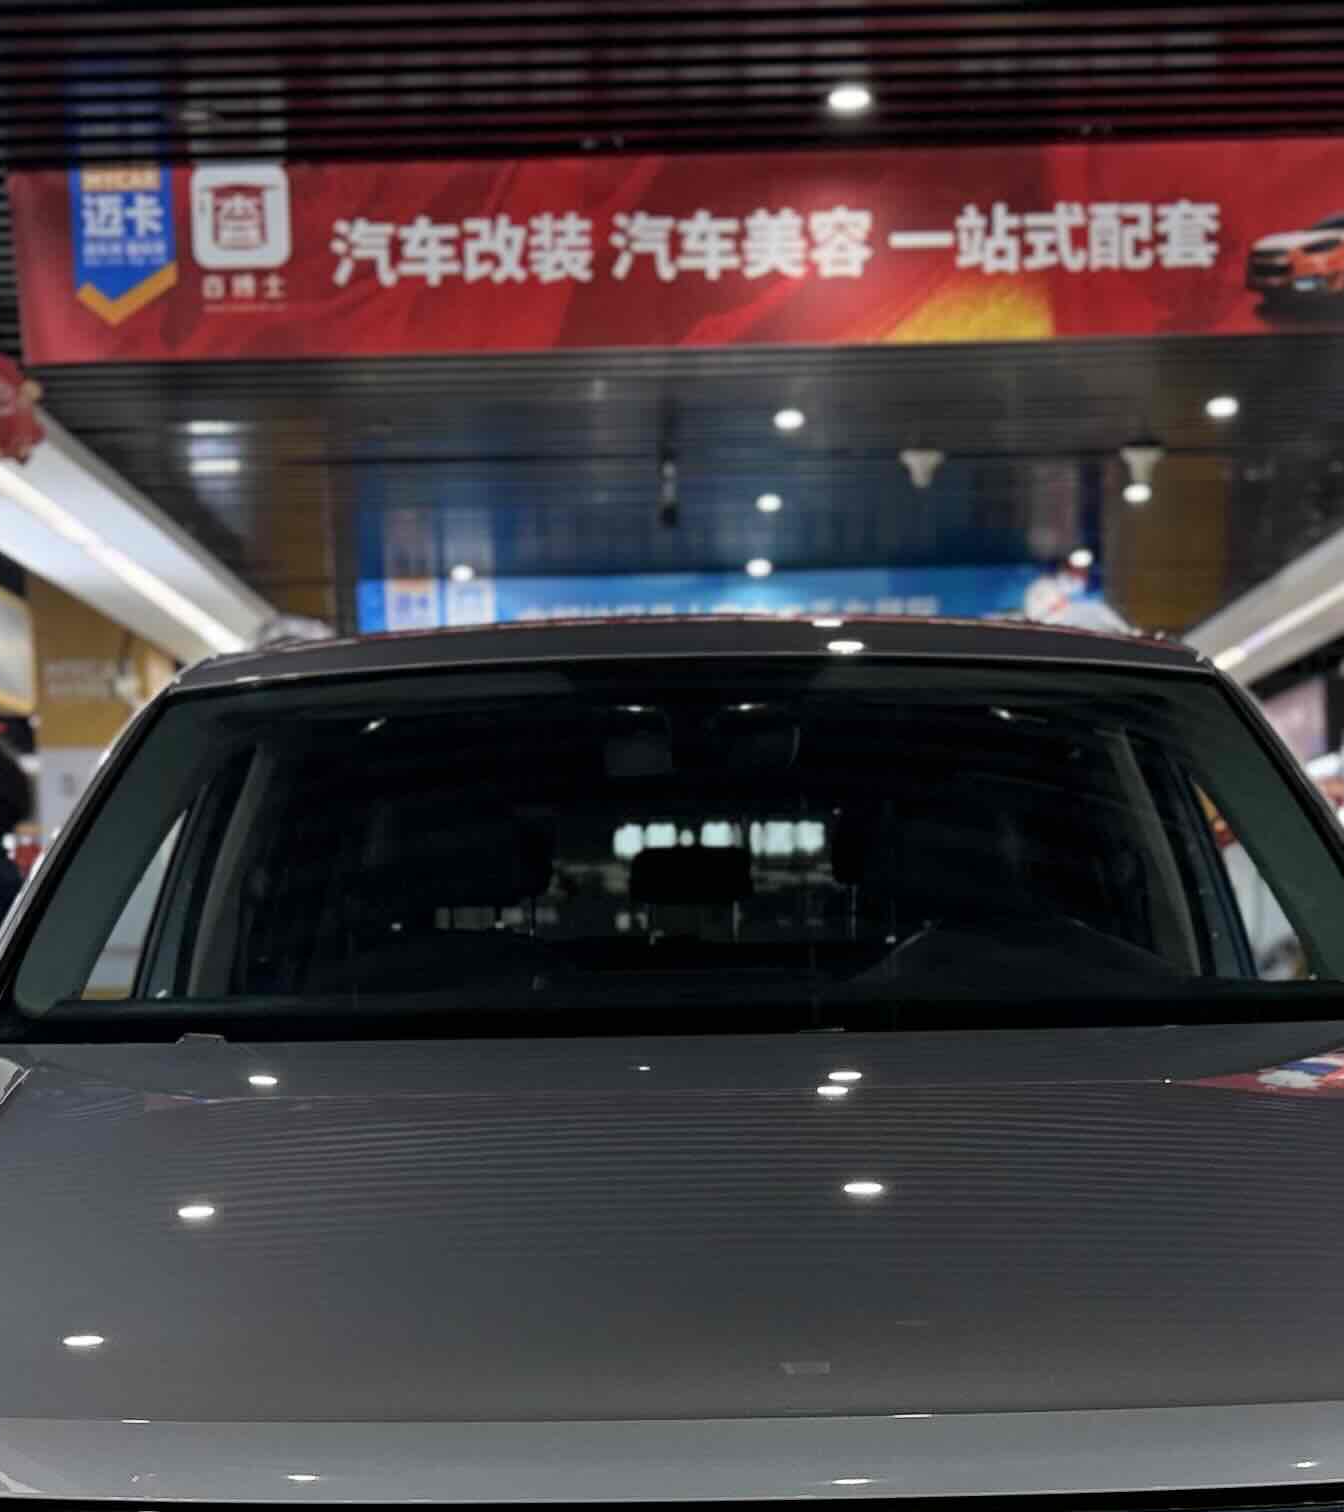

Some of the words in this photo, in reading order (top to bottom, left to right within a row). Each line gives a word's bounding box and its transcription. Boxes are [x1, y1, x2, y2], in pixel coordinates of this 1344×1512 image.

[82, 194, 164, 237] 迈卡
[331, 212, 593, 287] 汽车改装
[610, 206, 873, 281] 汽车美容
[888, 201, 1220, 274] 一站式配套
